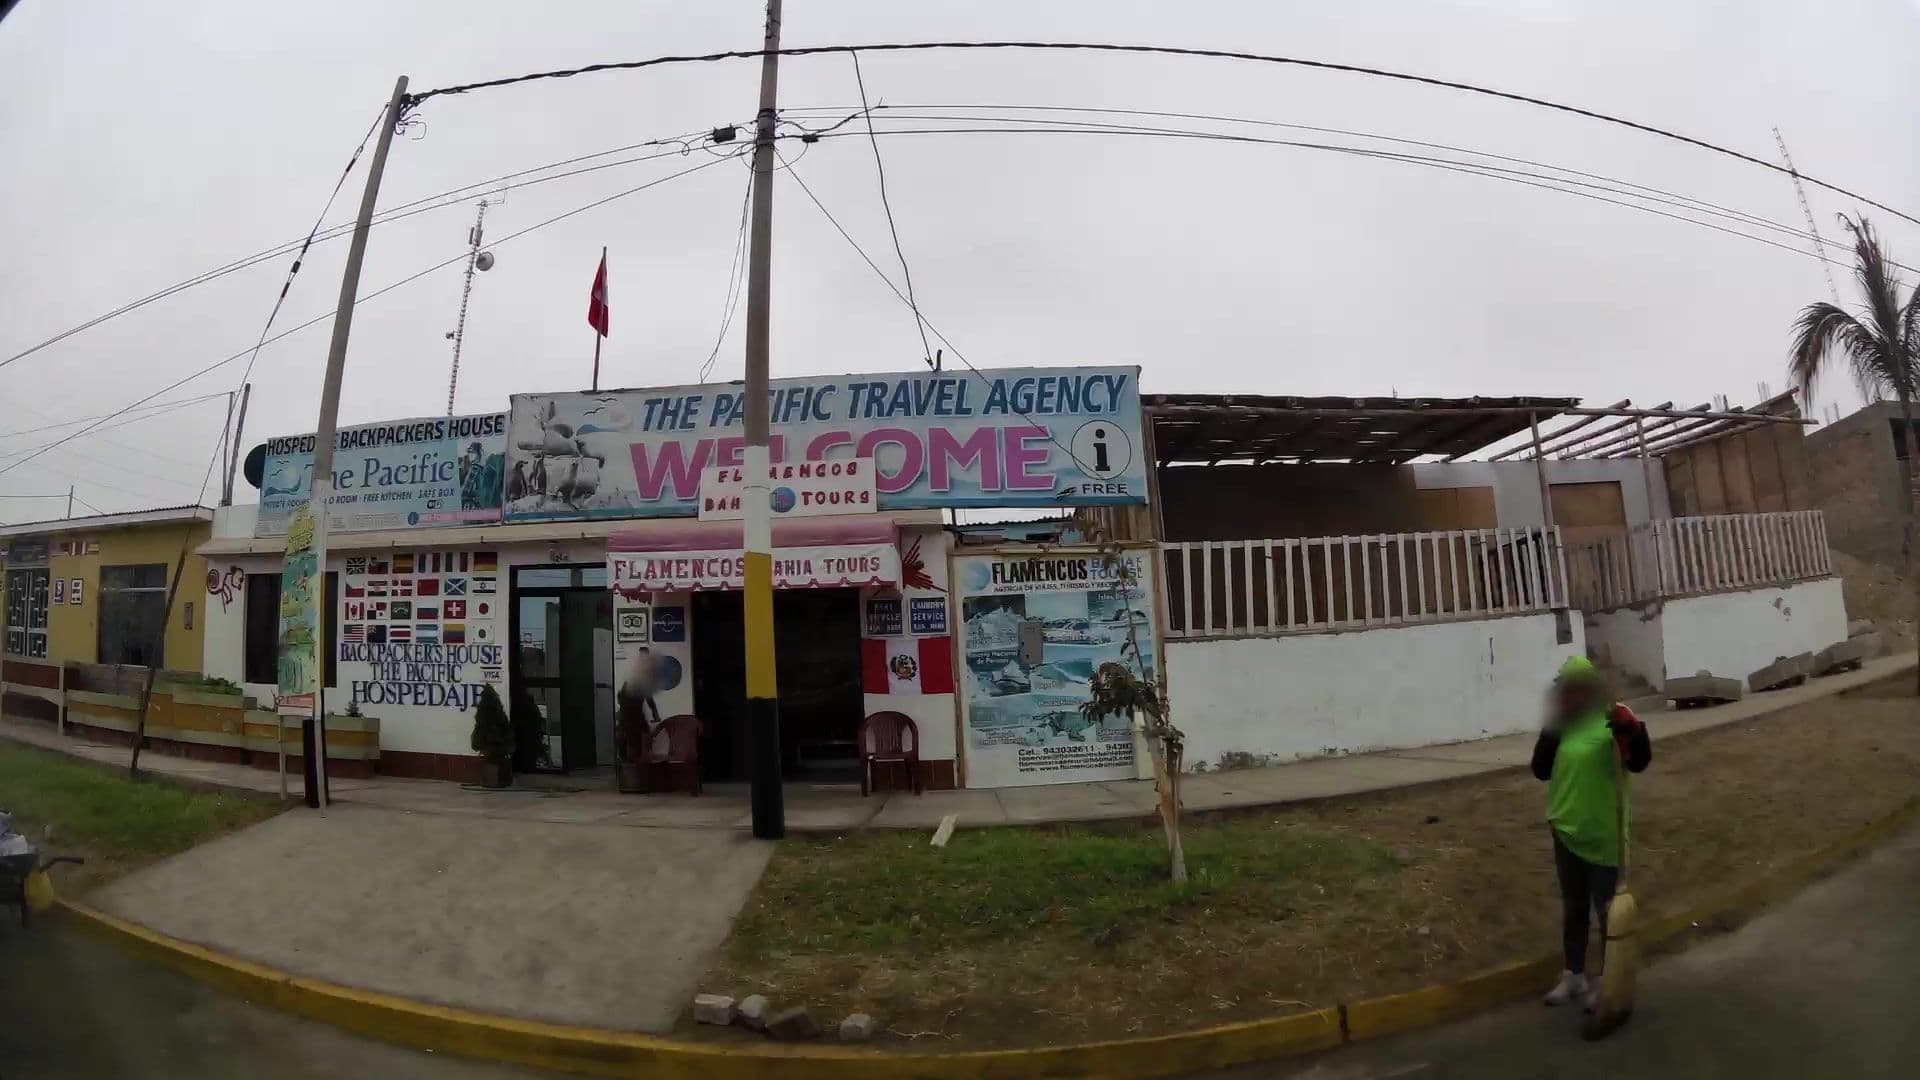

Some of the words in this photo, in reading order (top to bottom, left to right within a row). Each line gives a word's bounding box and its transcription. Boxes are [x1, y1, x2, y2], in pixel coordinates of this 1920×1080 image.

[643, 396, 703, 432] THE
[709, 384, 836, 428] PAIFIC
[848, 378, 973, 418] TRAVEL
[983, 374, 1127, 415] AGENCY
[340, 421, 445, 450] BACKPACKERS
[449, 414, 505, 438] HOUSE
[361, 452, 454, 488] Pacific
[718, 461, 858, 483] FLMENCOS
[363, 493, 379, 505] FREE
[379, 490, 412, 502] KITCHEN
[437, 487, 455, 498] BOX
[802, 490, 870, 506] TOURS
[1082, 483, 1128, 494] FREE
[615, 559, 745, 580] FLAMENCOS
[773, 558, 813, 577] AHIA
[823, 556, 881, 575] TOURS
[992, 559, 1088, 584] FLAMENCOS
[913, 612, 945, 621] SERVICE
[446, 644, 503, 665] HOUSE
[370, 661, 400, 681] THE
[406, 663, 462, 683] PACIFIC
